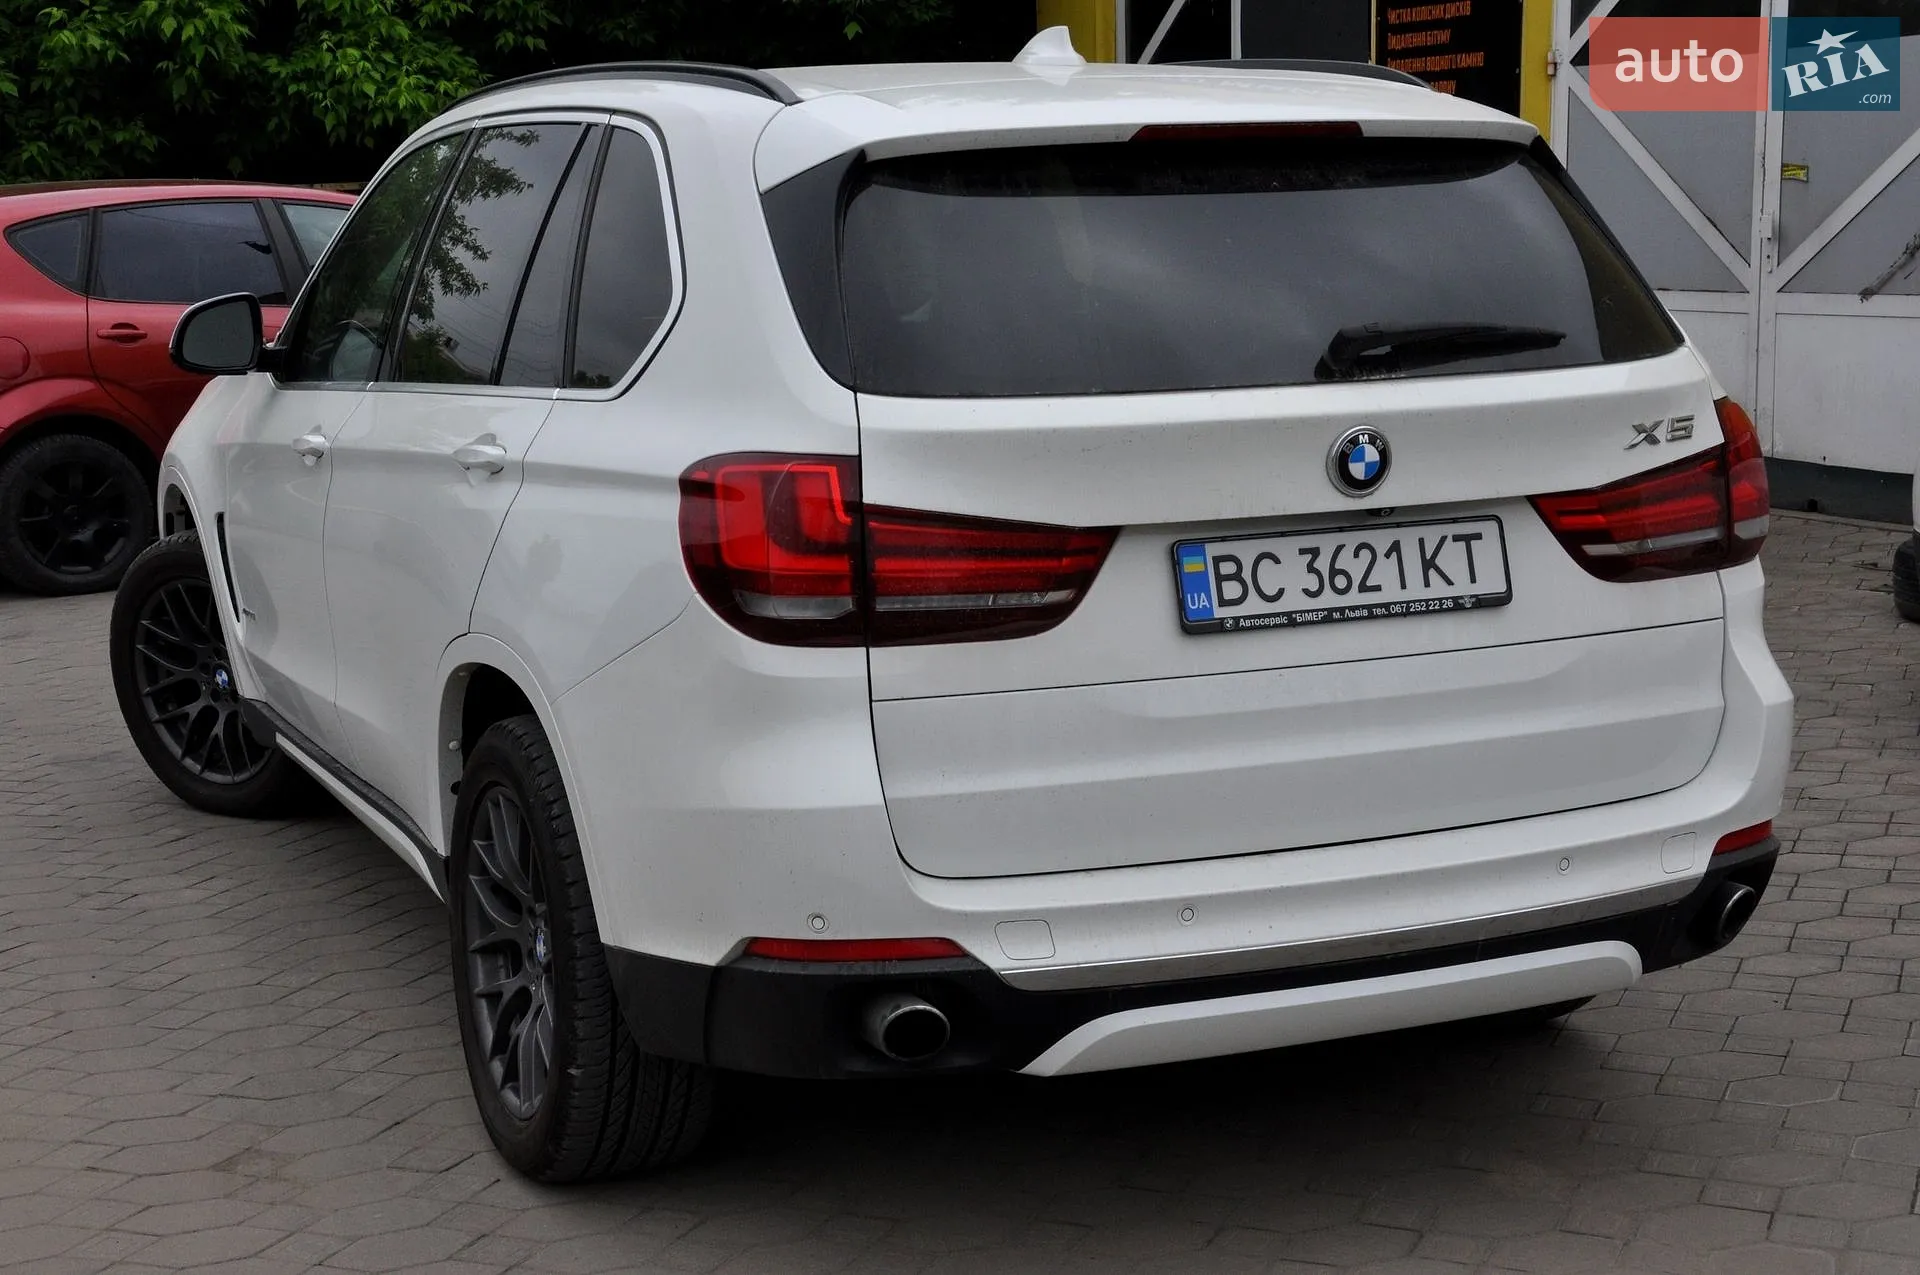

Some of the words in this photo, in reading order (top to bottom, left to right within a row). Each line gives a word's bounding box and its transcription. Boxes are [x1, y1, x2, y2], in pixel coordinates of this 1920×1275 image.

[1388, 8, 1411, 24] ЧИСТКА
[1411, 4, 1445, 22] КОЛІСНИХ
[1445, 1, 1471, 19] ДИСКІВ
[1426, 29, 1451, 46] БІТУМУ
[1426, 54, 1457, 72] ВОДНОГО
[1623, 414, 1695, 450] X5
[1343, 434, 1385, 455] BMW
[1212, 552, 1286, 608] BC
[1298, 540, 1407, 599] 3621
[1418, 532, 1483, 588] KT
[1187, 593, 1210, 609] UA
[1239, 614, 1288, 628] Автосервіс
[1292, 610, 1328, 623] "БІМЕР"
[1332, 611, 1343, 619] м.
[1344, 607, 1368, 618] Львів
[1371, 606, 1389, 616] тел.
[1390, 603, 1407, 614] 067
[1409, 601, 1426, 612] 252
[1428, 600, 1440, 610] 22
[1441, 598, 1454, 608] 26
